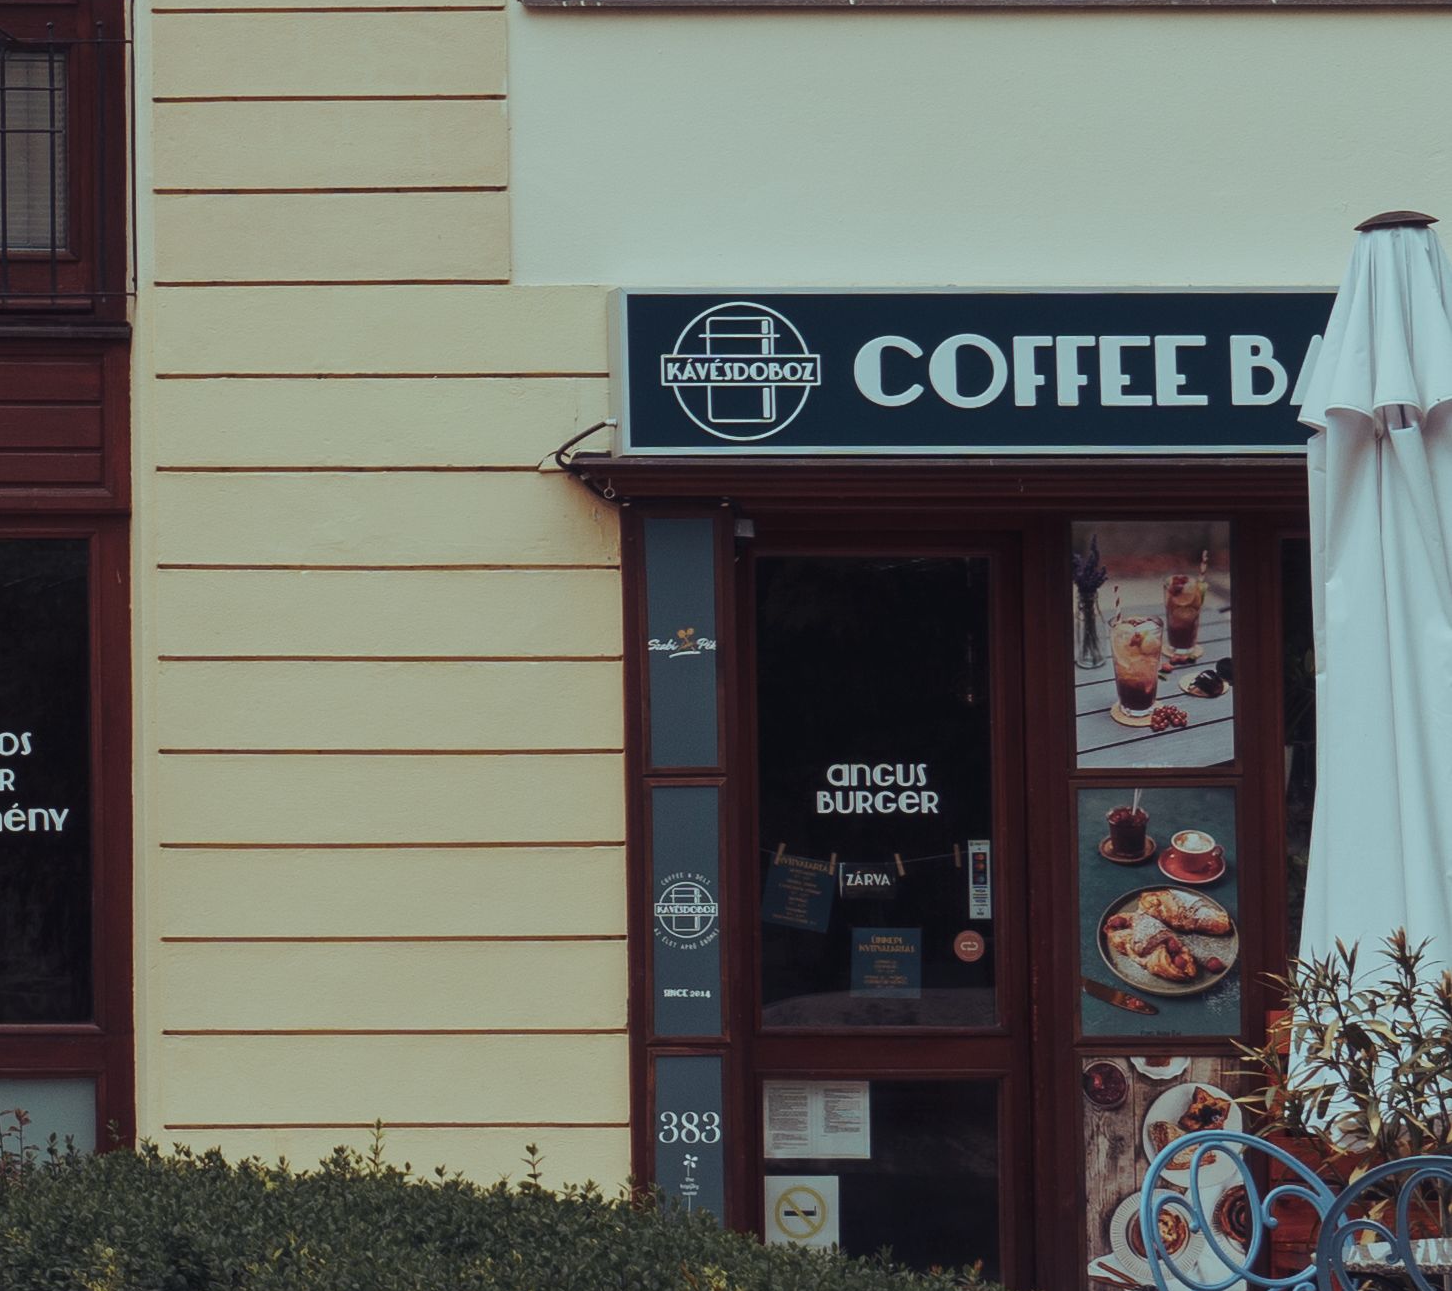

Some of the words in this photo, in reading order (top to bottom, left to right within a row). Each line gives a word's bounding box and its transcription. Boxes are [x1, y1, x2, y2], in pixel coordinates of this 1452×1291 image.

[667, 358, 815, 381] KÁVÉSDOBOZ
[853, 334, 1210, 408] COFFEE
[846, 871, 891, 886] ZÁRVA
[663, 989, 689, 998] SINCE
[658, 1111, 721, 1144] 383
